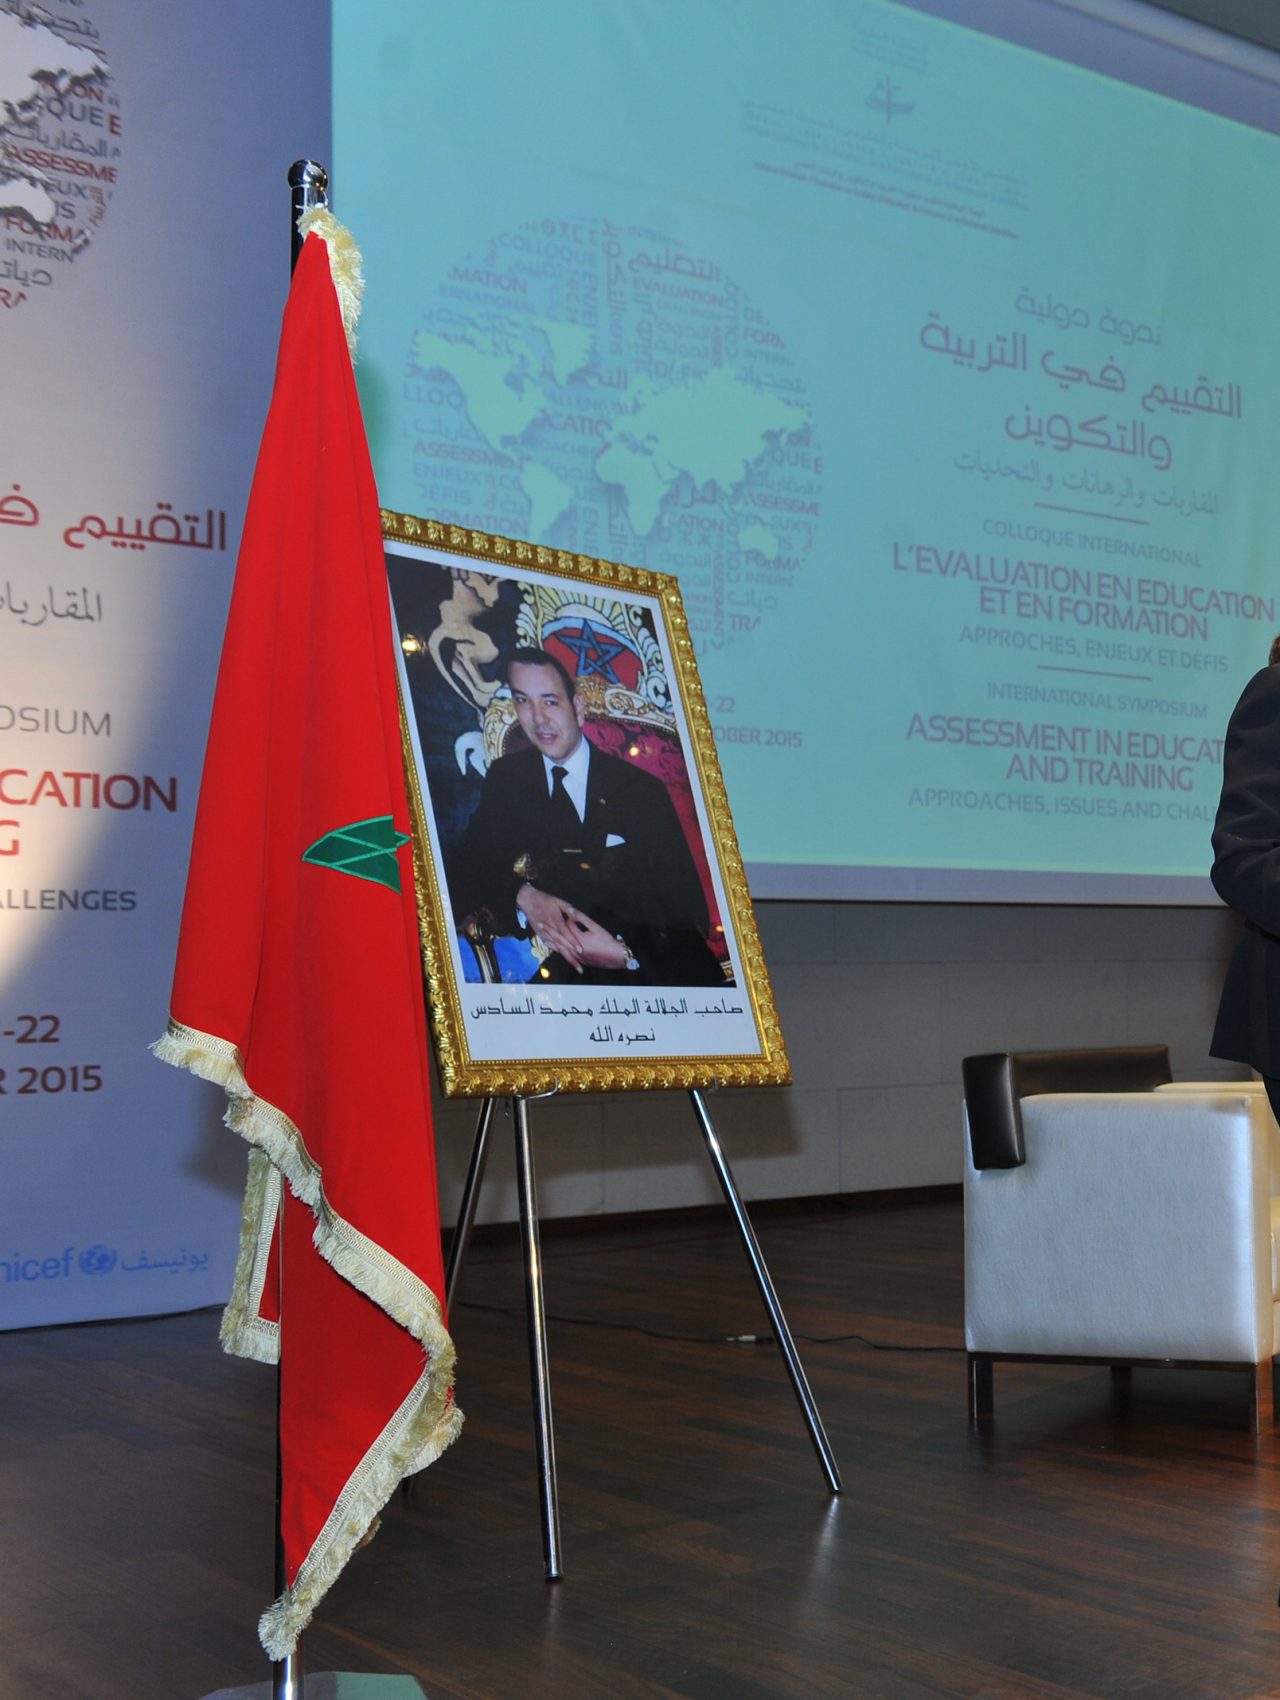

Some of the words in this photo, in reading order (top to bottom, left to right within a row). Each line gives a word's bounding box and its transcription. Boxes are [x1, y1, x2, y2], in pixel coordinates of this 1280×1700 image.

[919, 311, 1028, 373] التربية
[1041, 355, 1126, 392] في
[1141, 374, 1243, 420] التقييم
[1004, 403, 1173, 472] والتكوين
[63, 502, 227, 551] التقييم
[982, 517, 1075, 549] COLLOQUE
[1077, 534, 1204, 569] INTERNATIONAL
[892, 541, 1092, 598] L'EVALUATION
[1097, 572, 1133, 602] EN
[1137, 578, 1276, 623] EDUCATION
[979, 586, 1012, 614] ET
[1016, 590, 1054, 621] EN
[1058, 597, 1210, 642] FORMATION
[959, 624, 1081, 659] APPROCHES,
[1085, 640, 1153, 665] ENJEUX
[1157, 648, 1178, 666] ET
[987, 682, 1116, 711] INTERNATIONAL
[1117, 694, 1208, 719] SYMPOSIUM
[764, 729, 803, 748] 2015
[905, 713, 1092, 754] ASSESSMENT
[1096, 728, 1122, 757] IN
[0, 768, 178, 812] CATION
[1005, 753, 1070, 785] AND
[1073, 758, 1194, 792] TRAINING
[908, 787, 1051, 817] APPROACHES,
[1054, 795, 1118, 818] ISSUES
[1121, 799, 1162, 820] AND
[0, 888, 138, 912] LLENGES
[470, 997, 535, 1020] السادس
[539, 1004, 594, 1017] محمد
[598, 997, 641, 1018] الملك
[646, 998, 689, 1018] الجلالة
[694, 997, 744, 1018] صاحب
[589, 1025, 614, 1043] الله
[617, 1028, 656, 1046] نصره
[17, 1065, 103, 1094] 2015
